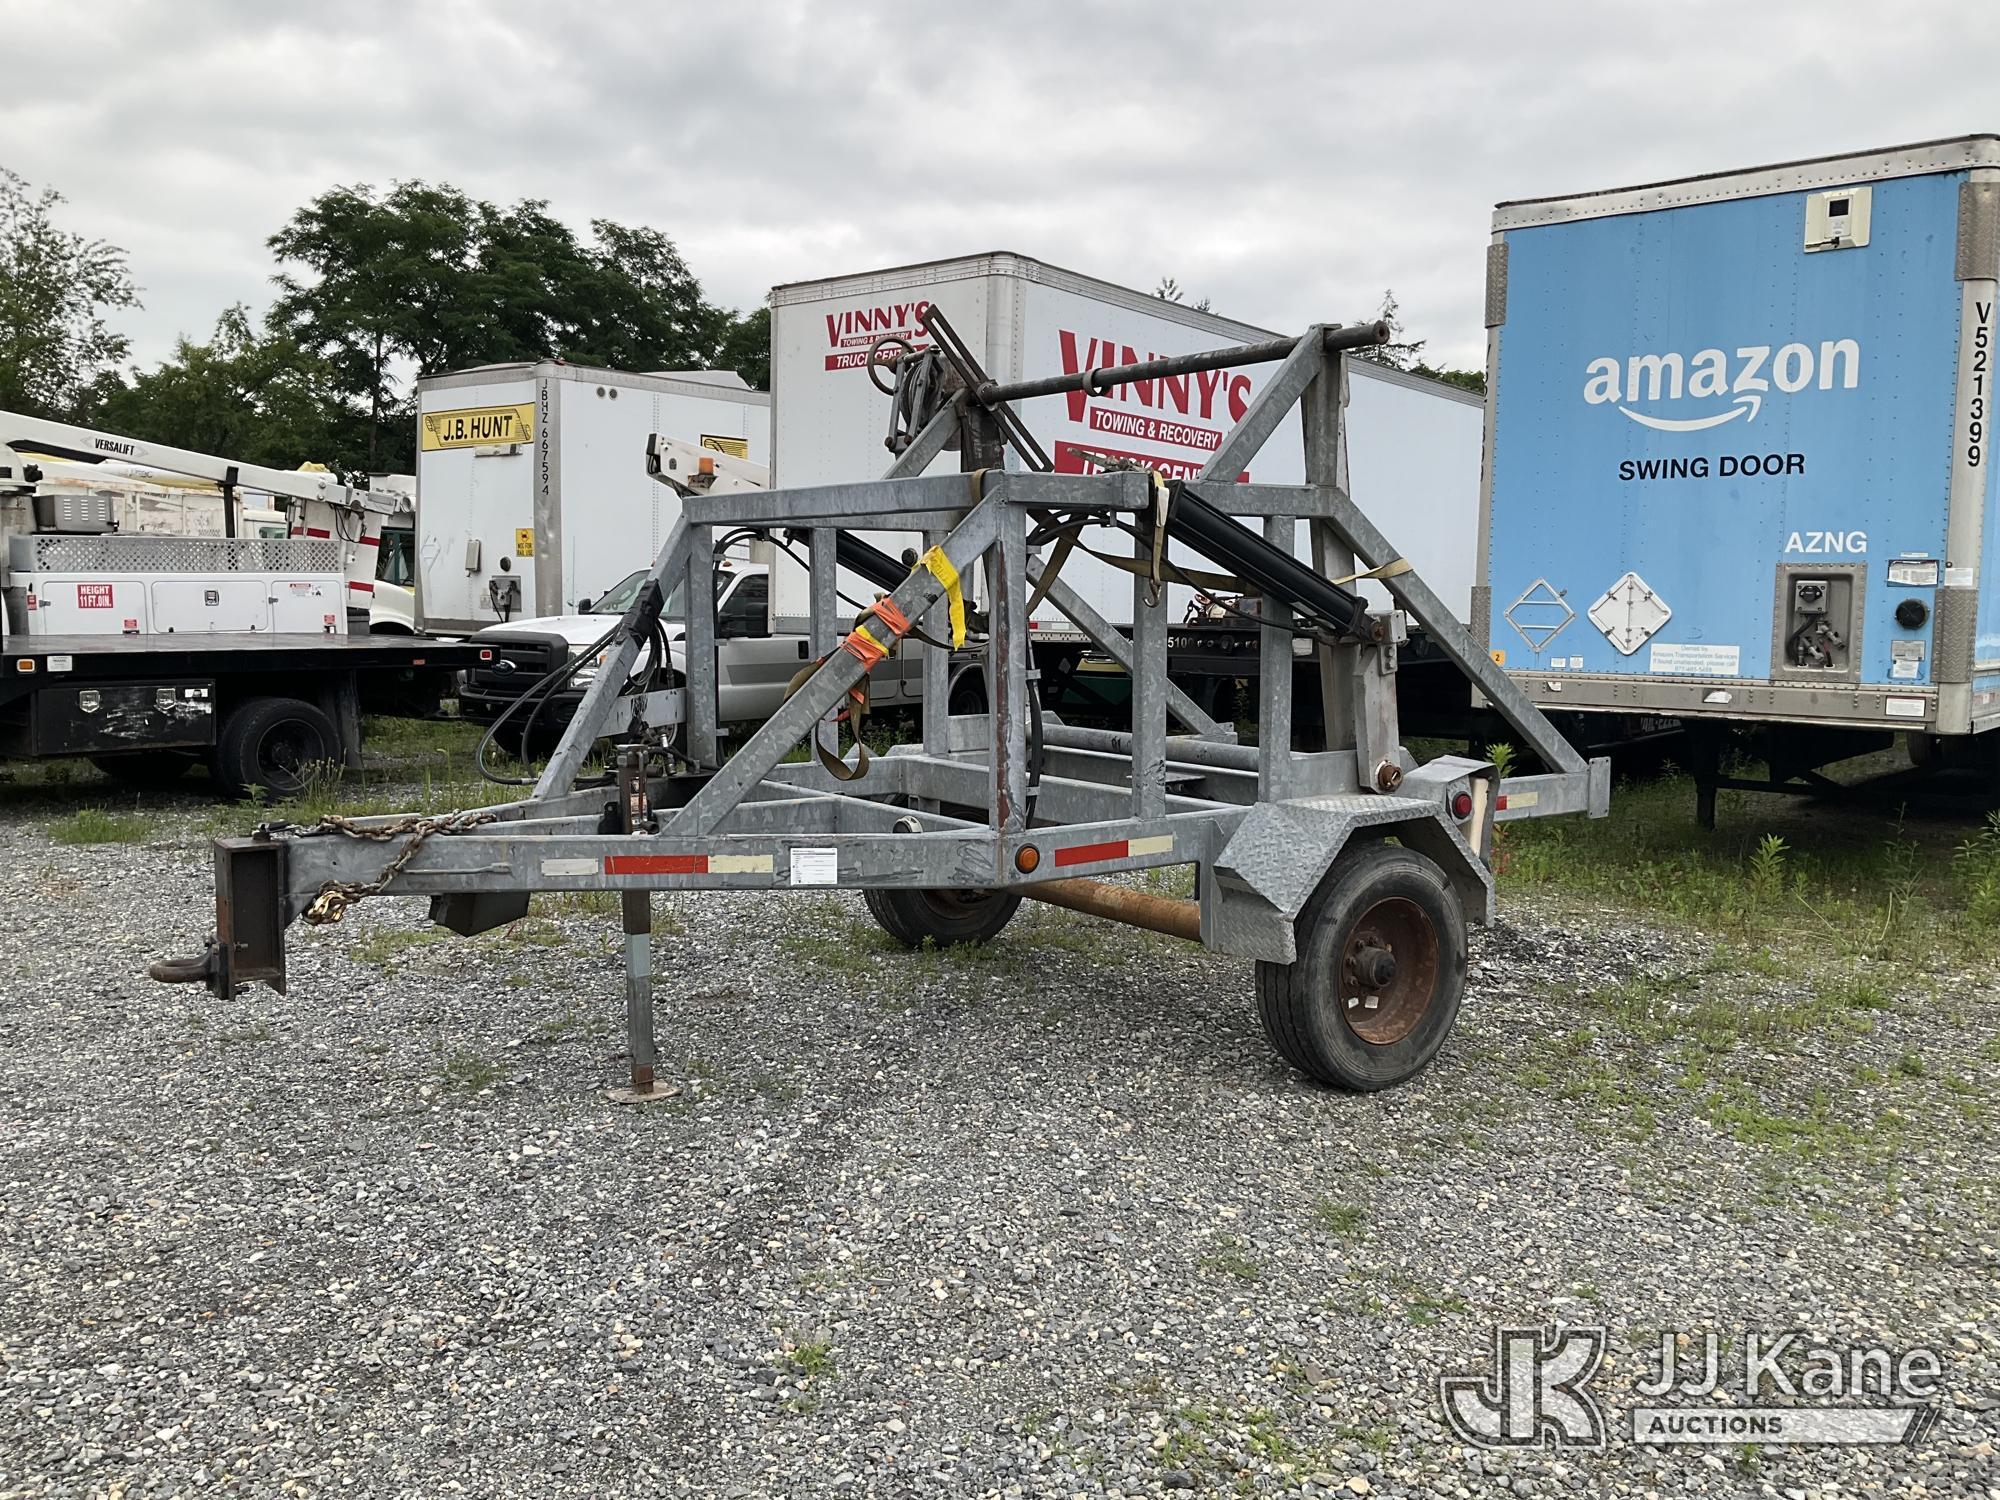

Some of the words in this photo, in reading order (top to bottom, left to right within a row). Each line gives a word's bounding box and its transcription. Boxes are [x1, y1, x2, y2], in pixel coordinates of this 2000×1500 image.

[826, 301, 930, 348] VINNY'S
[842, 338, 868, 347] TOWING
[869, 336, 874, 344] &
[1059, 329, 1251, 423] VINNY'S
[1583, 338, 1860, 404] amazon
[1967, 302, 1991, 467] V521399
[443, 419, 468, 441] J.B.
[470, 415, 512, 438] HUNT
[1095, 410, 1144, 436] TOWING
[1149, 421, 1156, 437] &
[1158, 424, 1219, 448] RECOVERY
[94, 438, 135, 455] VERSALIFT
[541, 427, 549, 495] 667594
[1618, 457, 1709, 481] SWING
[1719, 453, 1805, 477] DOOR
[1785, 531, 1867, 553] AZNG
[80, 585, 110, 595] HEIGHT
